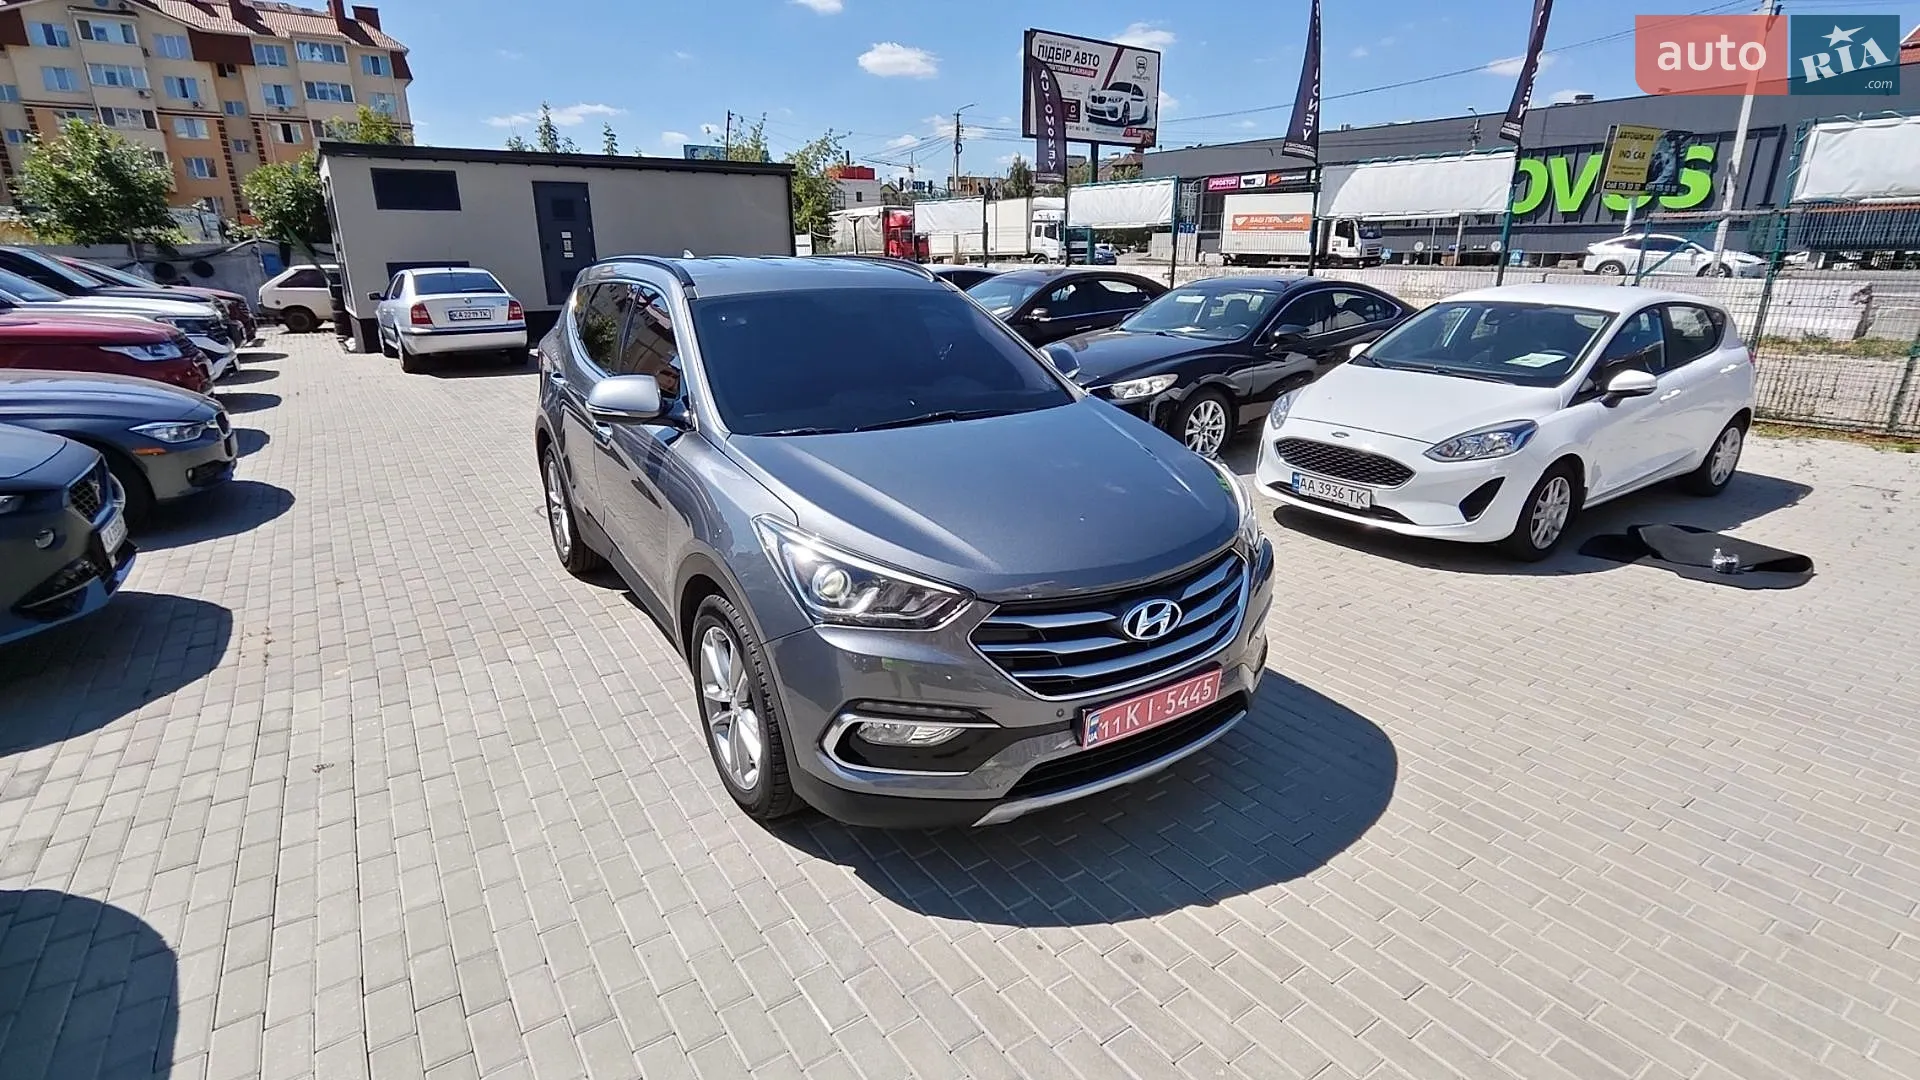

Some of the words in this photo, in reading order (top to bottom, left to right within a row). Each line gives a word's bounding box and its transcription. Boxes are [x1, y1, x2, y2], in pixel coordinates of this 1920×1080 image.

[1037, 44, 1072, 62] ПІДБІР
[1073, 51, 1100, 67] АВТО
[1300, 478, 1315, 492] AA
[1318, 481, 1345, 499] 3936
[1348, 489, 1366, 505] TK
